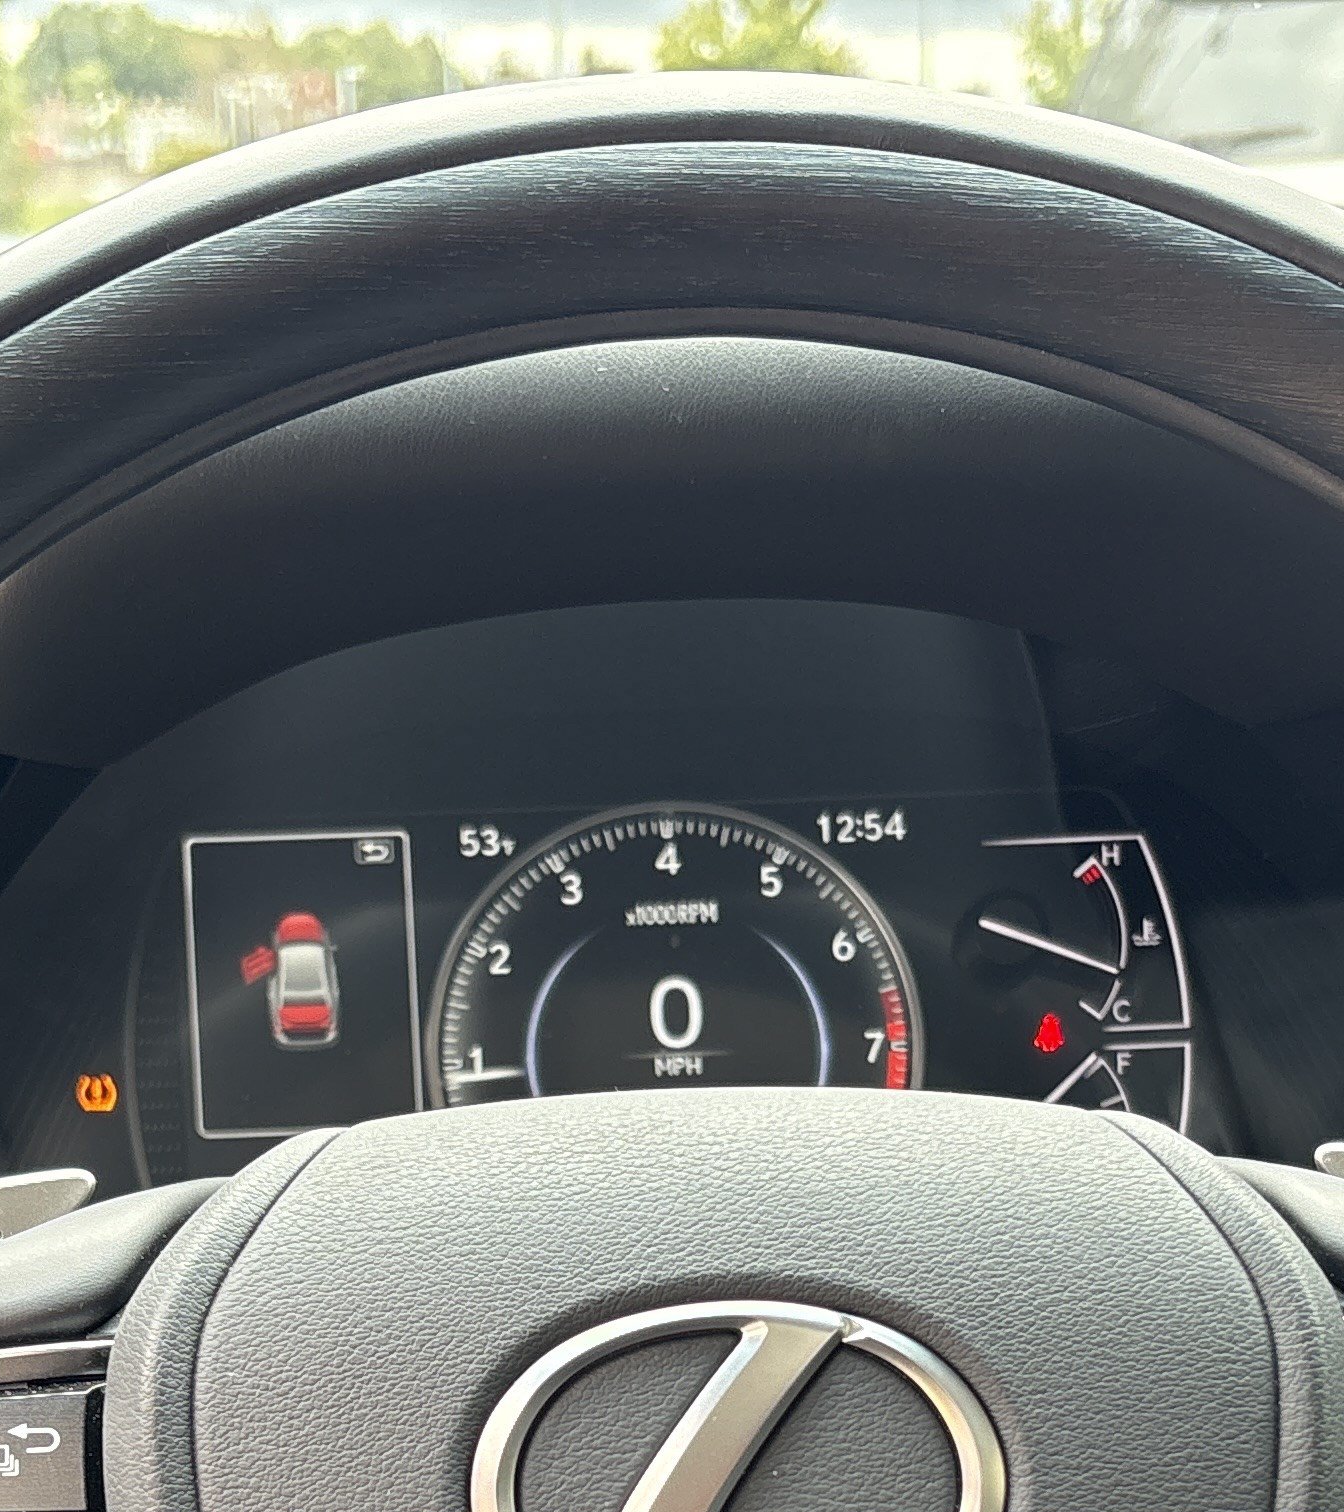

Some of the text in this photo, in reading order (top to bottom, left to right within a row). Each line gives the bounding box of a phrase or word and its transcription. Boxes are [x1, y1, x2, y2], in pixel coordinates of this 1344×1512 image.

[816, 811, 907, 844] 12:54
[654, 841, 682, 876] 4
[1100, 843, 1122, 867] H
[559, 870, 584, 906] 3
[759, 862, 784, 898] 5
[488, 941, 513, 977] 2
[831, 928, 856, 963] 6
[649, 974, 705, 1050] 0
[1111, 999, 1132, 1023] C
[468, 1042, 485, 1076] 1
[863, 1028, 886, 1064] 7
[1116, 1051, 1133, 1075] F
[654, 1056, 705, 1078] MPH
